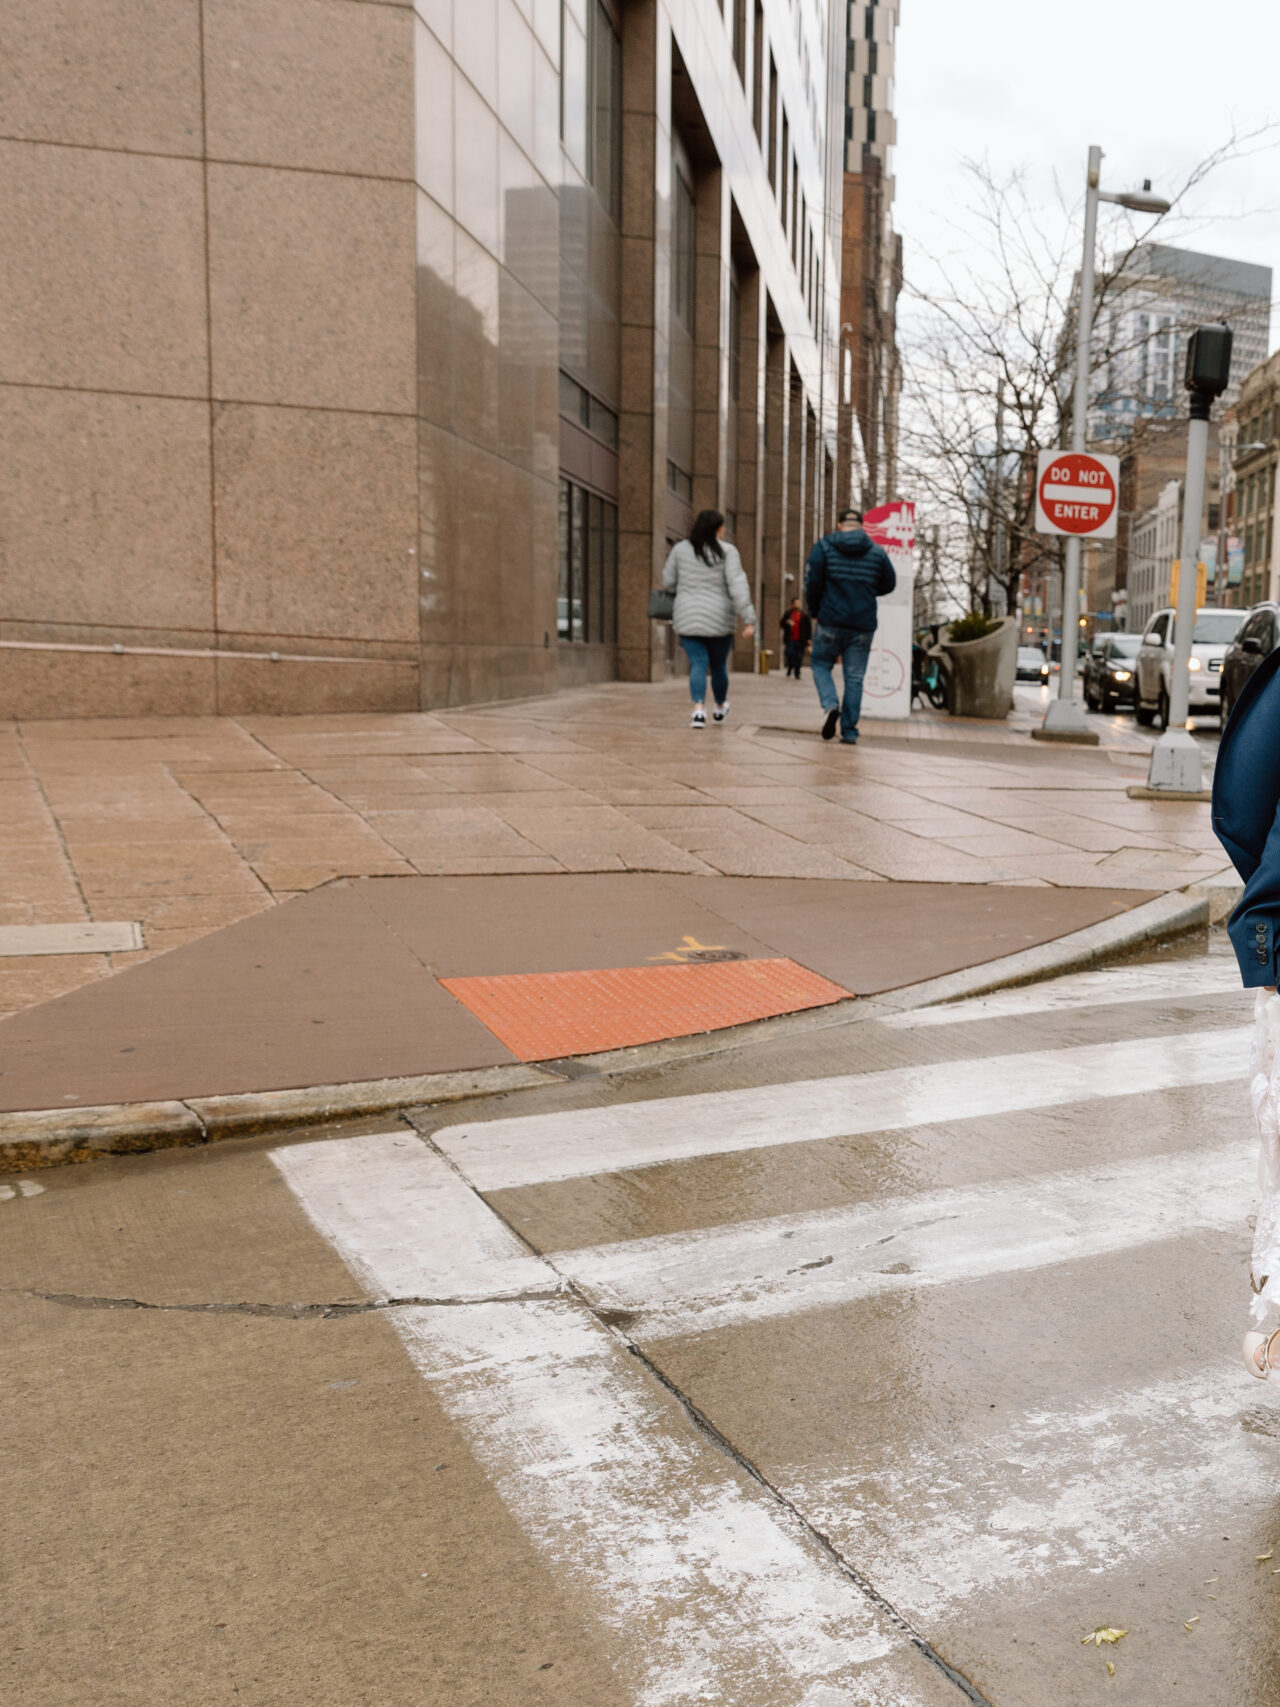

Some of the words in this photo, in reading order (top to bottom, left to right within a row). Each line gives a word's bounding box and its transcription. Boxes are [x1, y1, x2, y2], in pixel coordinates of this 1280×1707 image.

[1051, 467, 1070, 482] DO
[1078, 470, 1106, 484] NOT
[1054, 503, 1099, 520] ENTER
